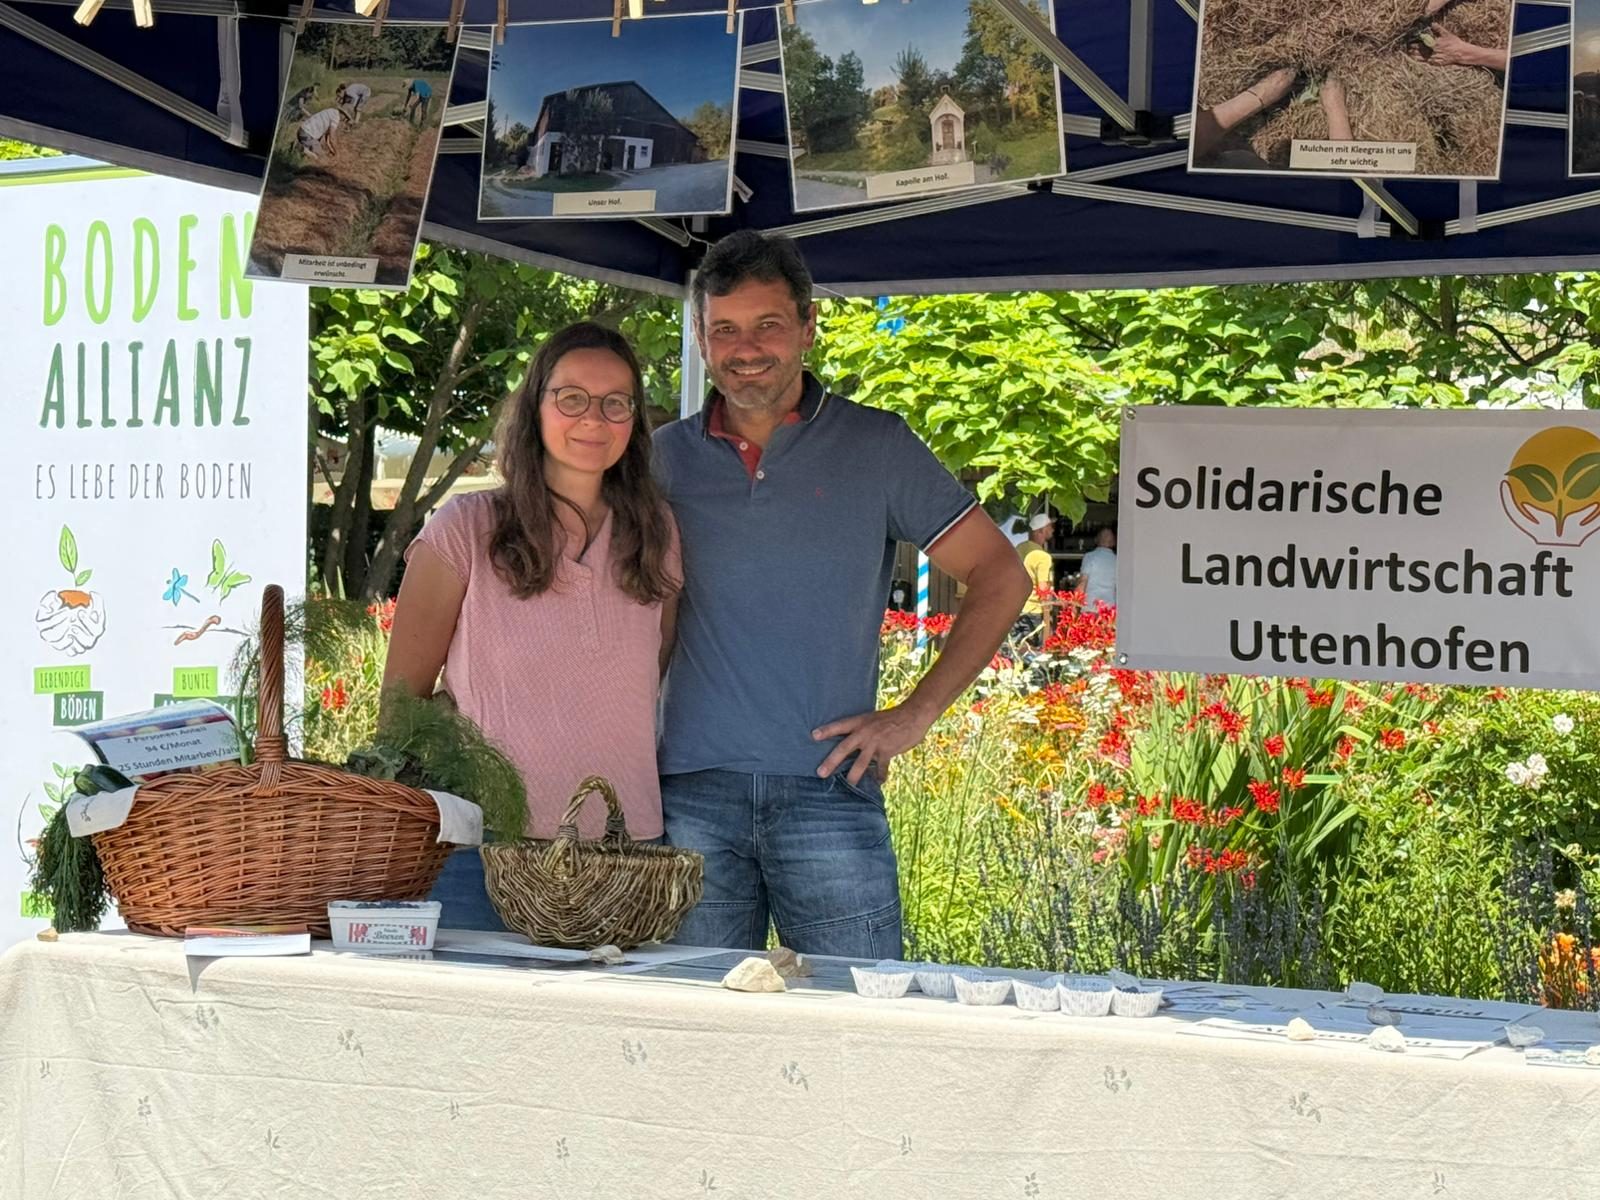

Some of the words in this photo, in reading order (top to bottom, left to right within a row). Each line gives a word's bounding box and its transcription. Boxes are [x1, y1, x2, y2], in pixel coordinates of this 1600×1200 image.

[1300, 144, 1334, 153] Mulchen
[1335, 145, 1349, 153] mit
[1350, 145, 1384, 155] Kleegras
[1385, 146, 1396, 154] ist
[1349, 158, 1379, 168] wichtig
[922, 175, 934, 183] am
[43, 211, 254, 327] BODEN
[40, 337, 252, 429] ALLIANZ
[36, 463, 56, 499] ES
[69, 463, 116, 499] LEBE
[129, 463, 165, 499] DER
[180, 462, 252, 499] BODEN
[1135, 465, 1443, 516] Solidarische
[1180, 542, 1574, 598] Landwirtschaft
[1229, 619, 1530, 674] Uttenhofen
[40, 670, 84, 689] LEBENDIGE
[182, 672, 210, 691] BUNTE
[60, 694, 96, 721] BÖDEN
[118, 764, 132, 772] 25
[132, 757, 174, 771] Stunden
